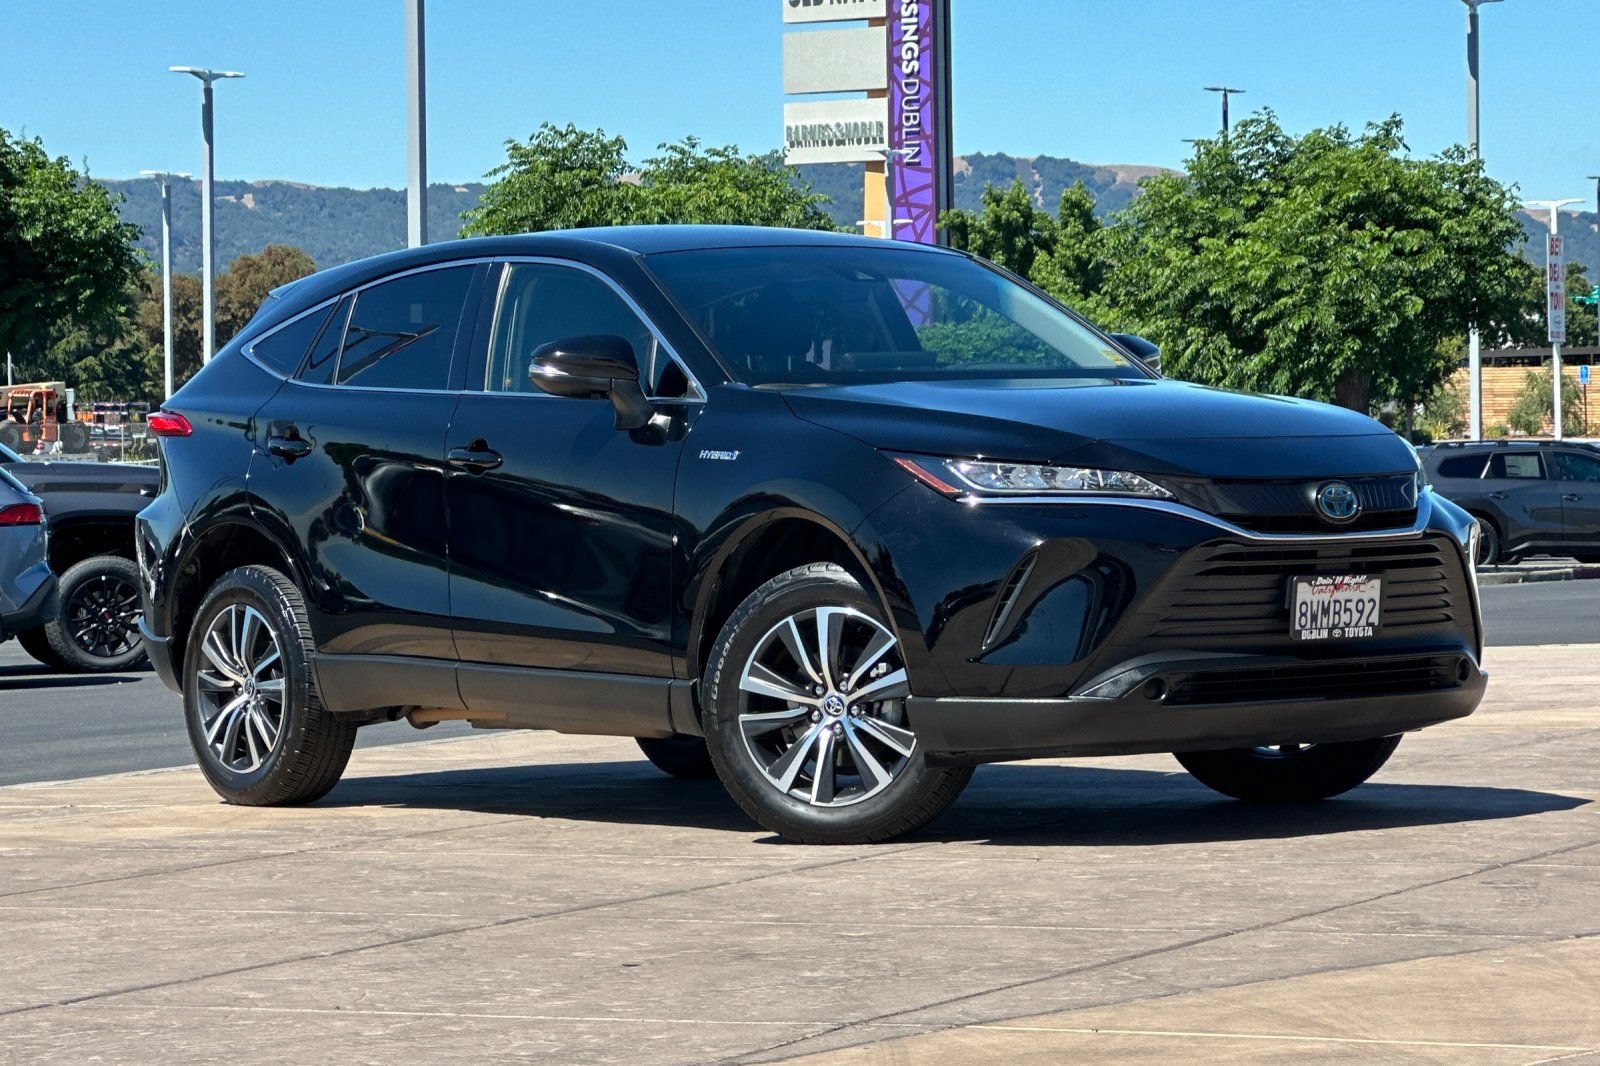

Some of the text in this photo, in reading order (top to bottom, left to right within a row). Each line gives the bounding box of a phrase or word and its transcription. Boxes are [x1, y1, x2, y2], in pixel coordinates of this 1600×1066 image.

[901, 0, 920, 163] SINGS DUBLIN
[1299, 598, 1376, 629] 8WMB592
[1301, 626, 1373, 640] DUBLIN TOYOTA
